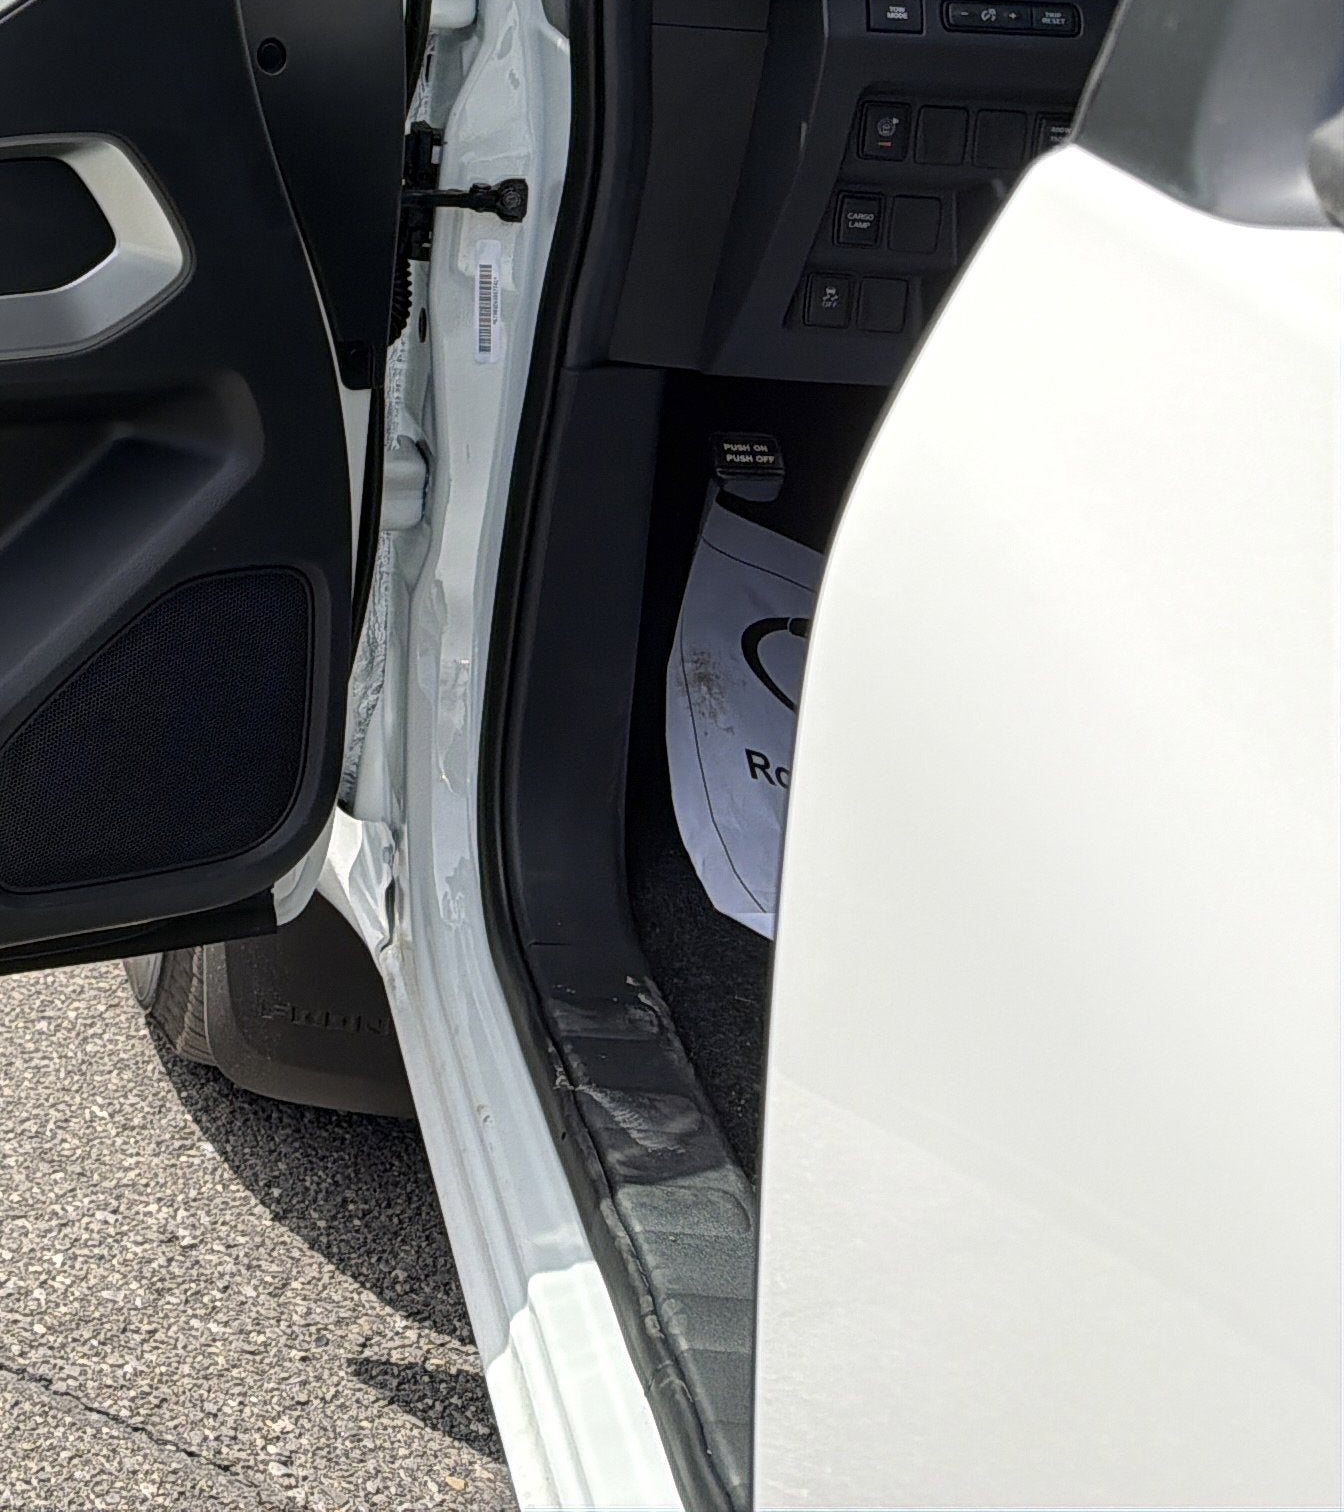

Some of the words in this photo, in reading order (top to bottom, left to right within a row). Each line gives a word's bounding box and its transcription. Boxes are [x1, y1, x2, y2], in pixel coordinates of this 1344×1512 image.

[847, 212, 874, 221] CARGO
[849, 221, 871, 229] LAMP
[723, 443, 750, 452] PUSH
[753, 444, 768, 452] ON
[726, 454, 753, 463] PUSH
[756, 455, 775, 463] OFF
